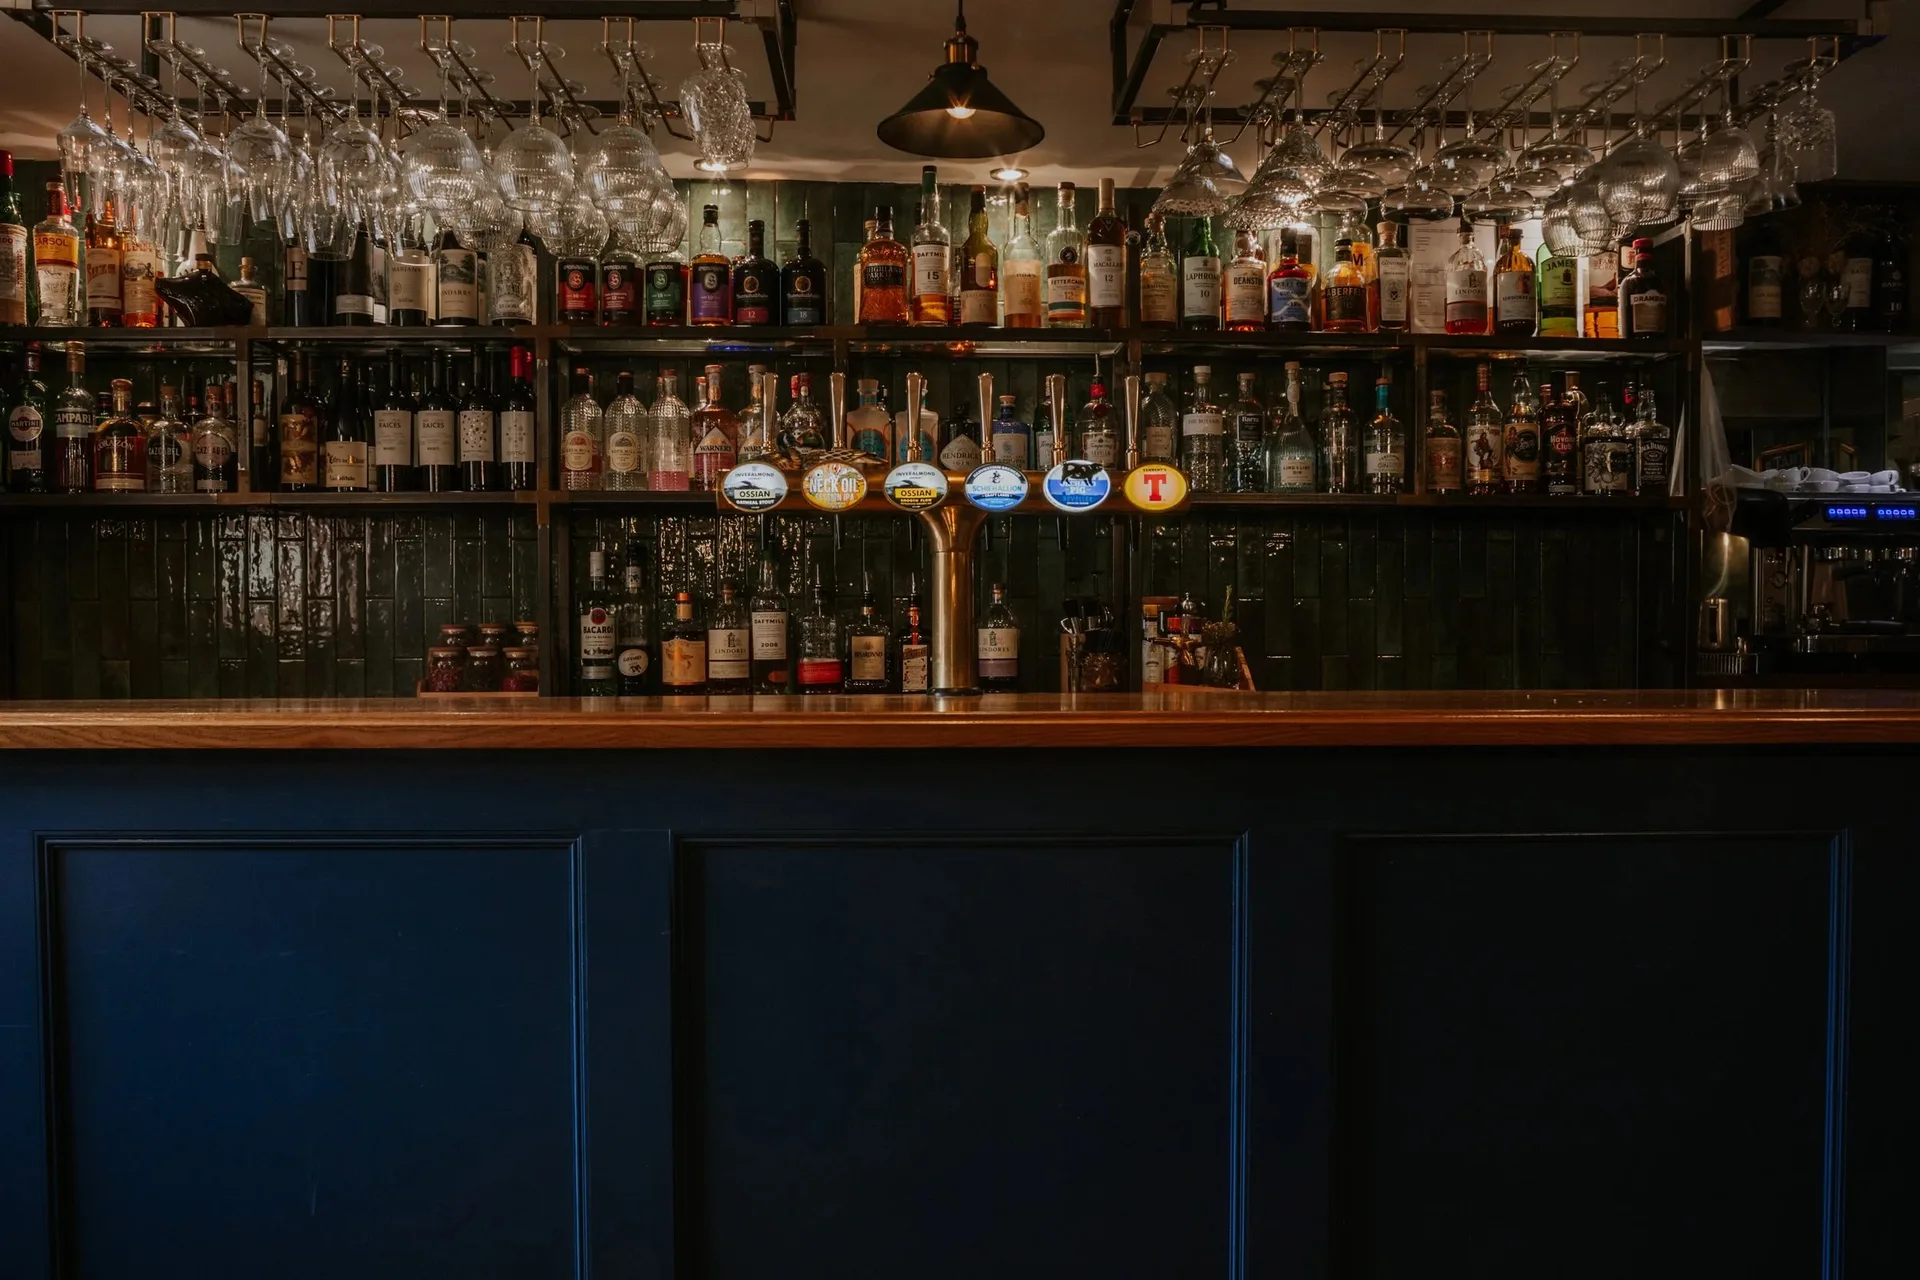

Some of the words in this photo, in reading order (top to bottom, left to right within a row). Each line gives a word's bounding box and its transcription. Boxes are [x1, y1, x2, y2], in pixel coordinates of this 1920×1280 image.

[927, 271, 940, 280] 15
[747, 311, 756, 319] 12
[800, 311, 809, 319] 18
[810, 477, 838, 493] NECK
[841, 477, 859, 493] OIL
[1143, 474, 1167, 502] T
